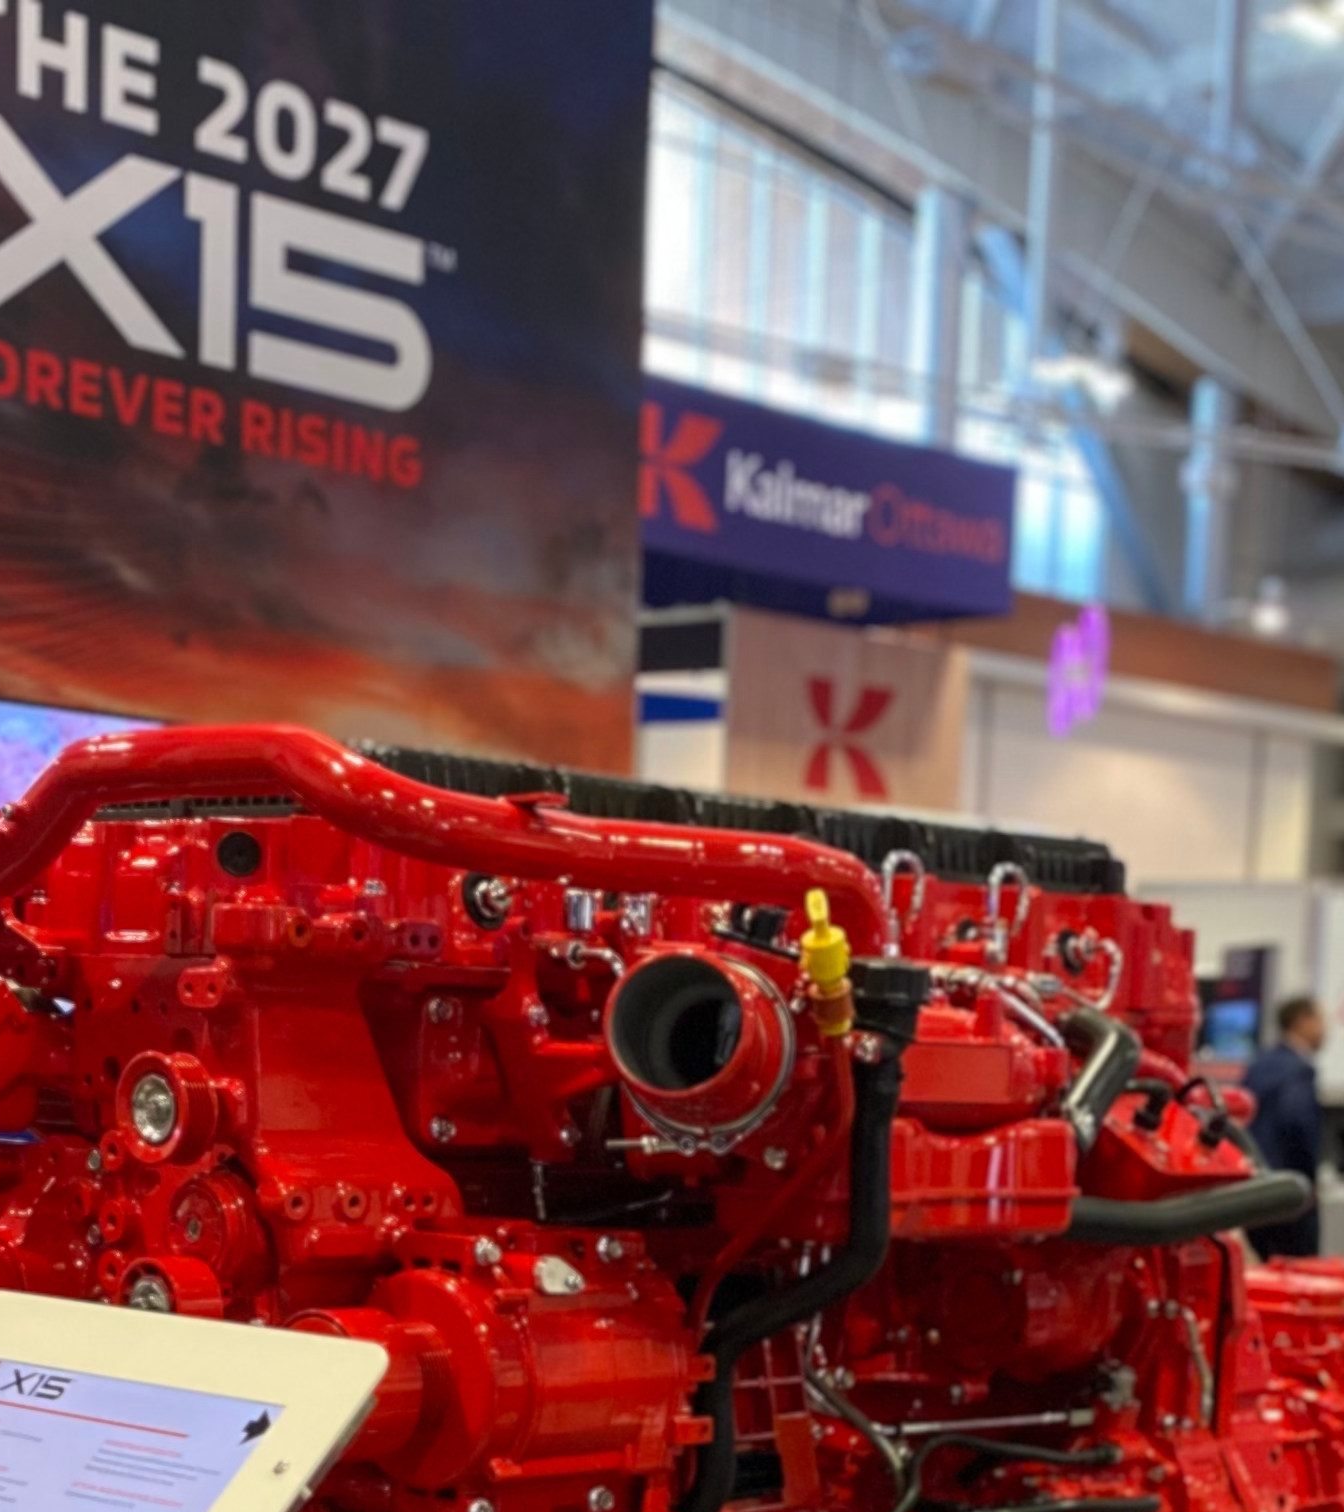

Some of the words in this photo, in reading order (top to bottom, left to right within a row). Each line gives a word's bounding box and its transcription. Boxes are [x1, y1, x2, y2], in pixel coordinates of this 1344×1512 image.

[195, 55, 429, 213] 2027
[240, 402, 422, 487] RISING
[724, 447, 870, 540] Kalmar
